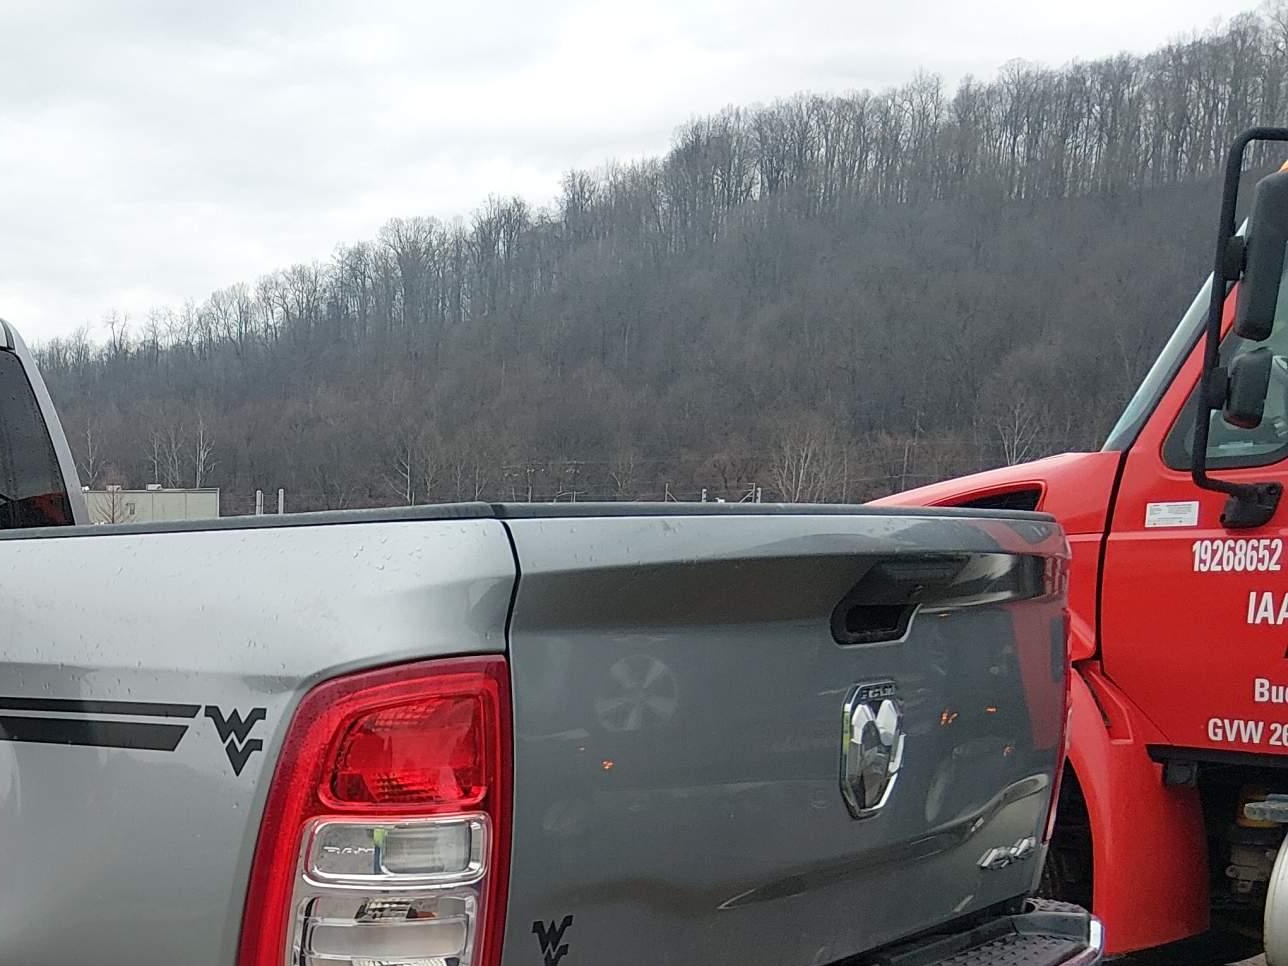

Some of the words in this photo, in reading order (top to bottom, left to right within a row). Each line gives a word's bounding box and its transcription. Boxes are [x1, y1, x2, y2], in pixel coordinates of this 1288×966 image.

[1192, 538, 1283, 572] 19268652
[1254, 678, 1288, 703] Bu
[1208, 718, 1264, 744] GVW
